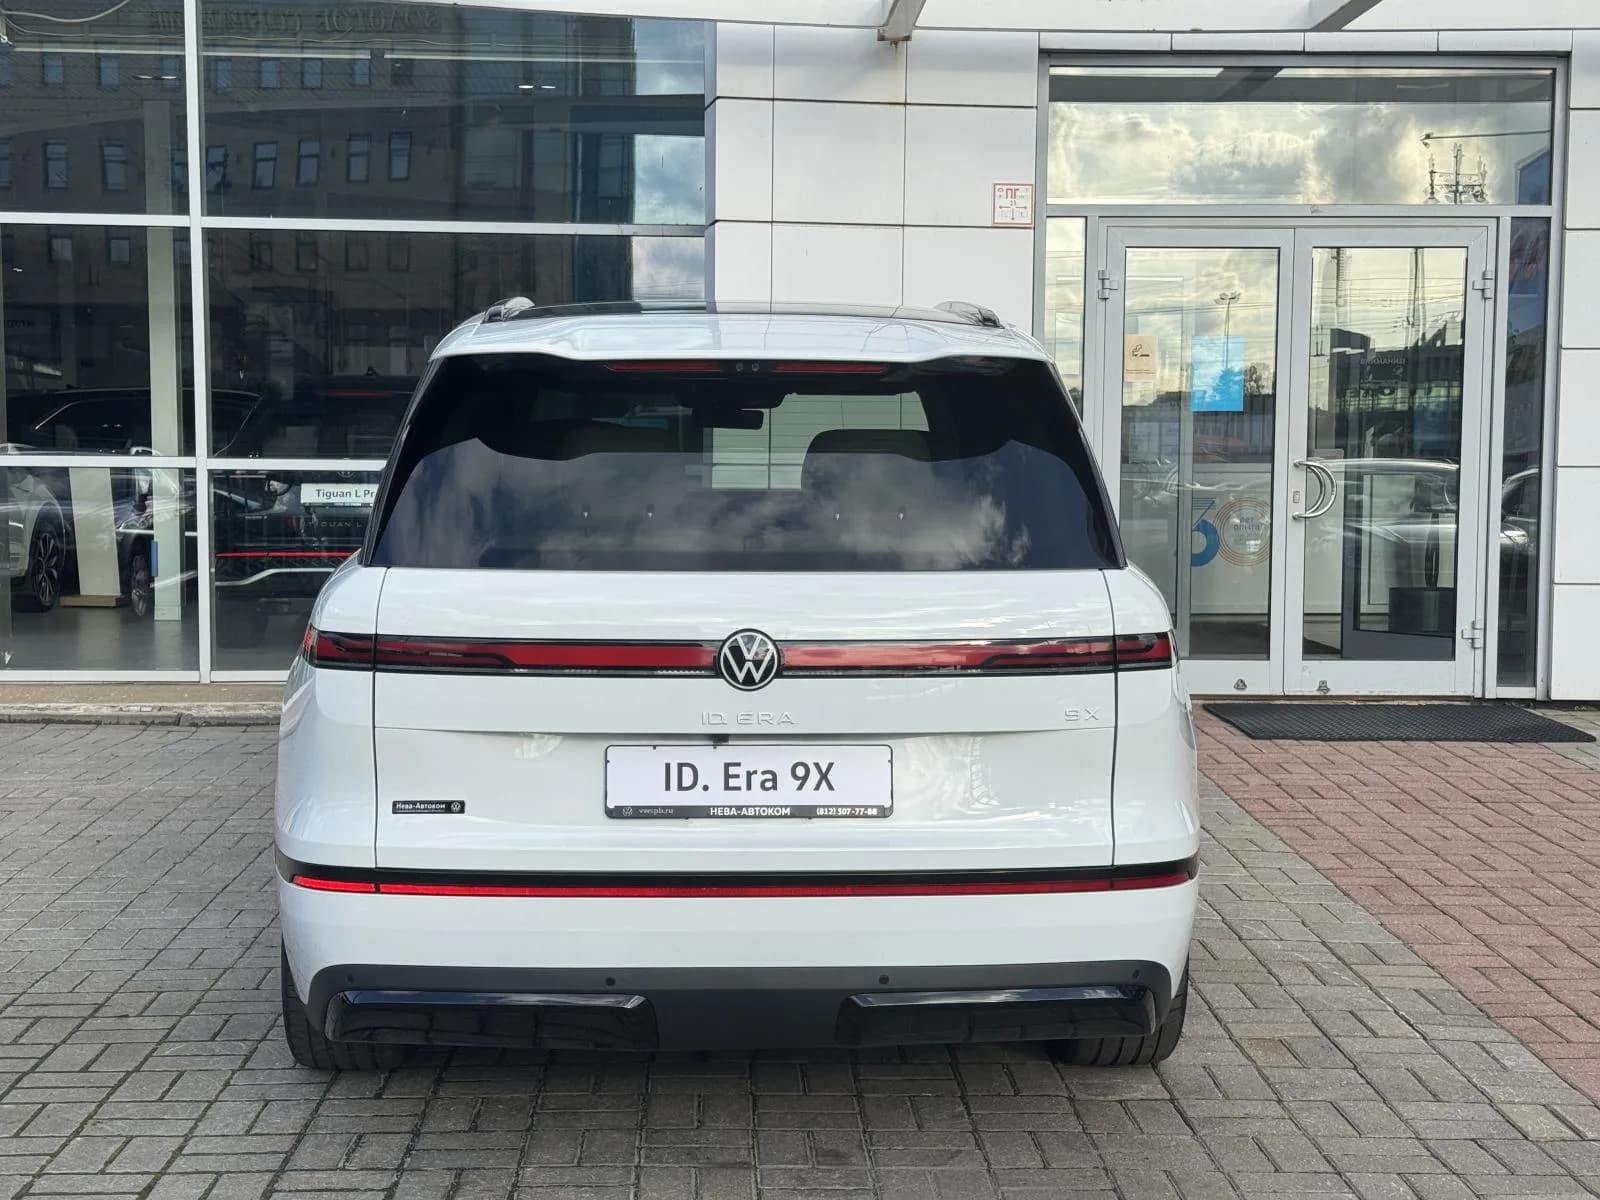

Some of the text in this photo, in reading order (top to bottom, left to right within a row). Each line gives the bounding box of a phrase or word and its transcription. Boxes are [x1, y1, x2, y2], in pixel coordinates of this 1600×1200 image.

[316, 489, 352, 499] Tiguan
[355, 489, 361, 498] L
[737, 711, 796, 726] ERA
[664, 761, 835, 792] ID. Era 9X
[710, 807, 791, 816] НЕВА-АВТОКОМ
[816, 807, 836, 816] (812)
